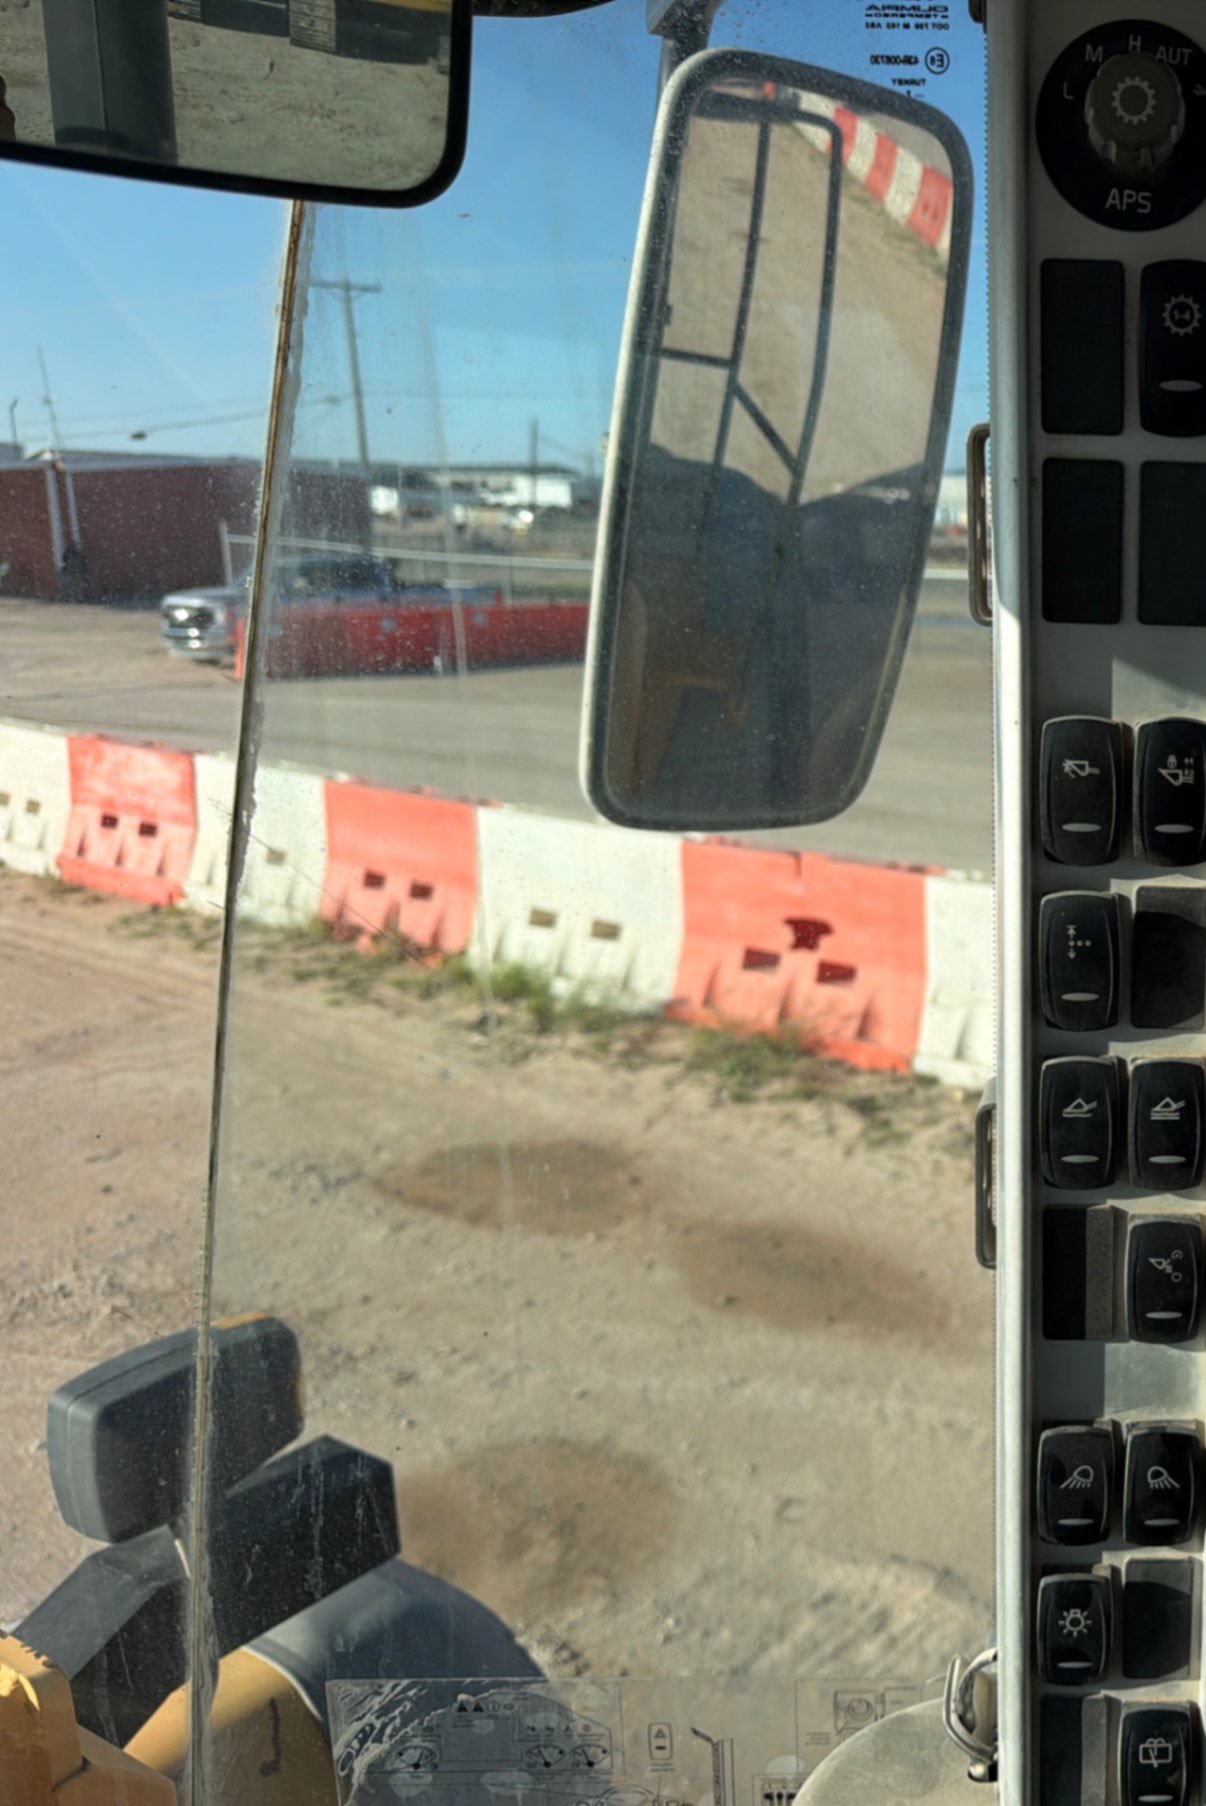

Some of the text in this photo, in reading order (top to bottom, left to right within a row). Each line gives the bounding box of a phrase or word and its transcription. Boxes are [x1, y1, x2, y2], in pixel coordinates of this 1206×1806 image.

[1129, 34, 1141, 51] H
[1085, 44, 1103, 63] M
[1155, 46, 1193, 66] AUT
[1063, 81, 1075, 100] L
[1105, 188, 1152, 214] APS
